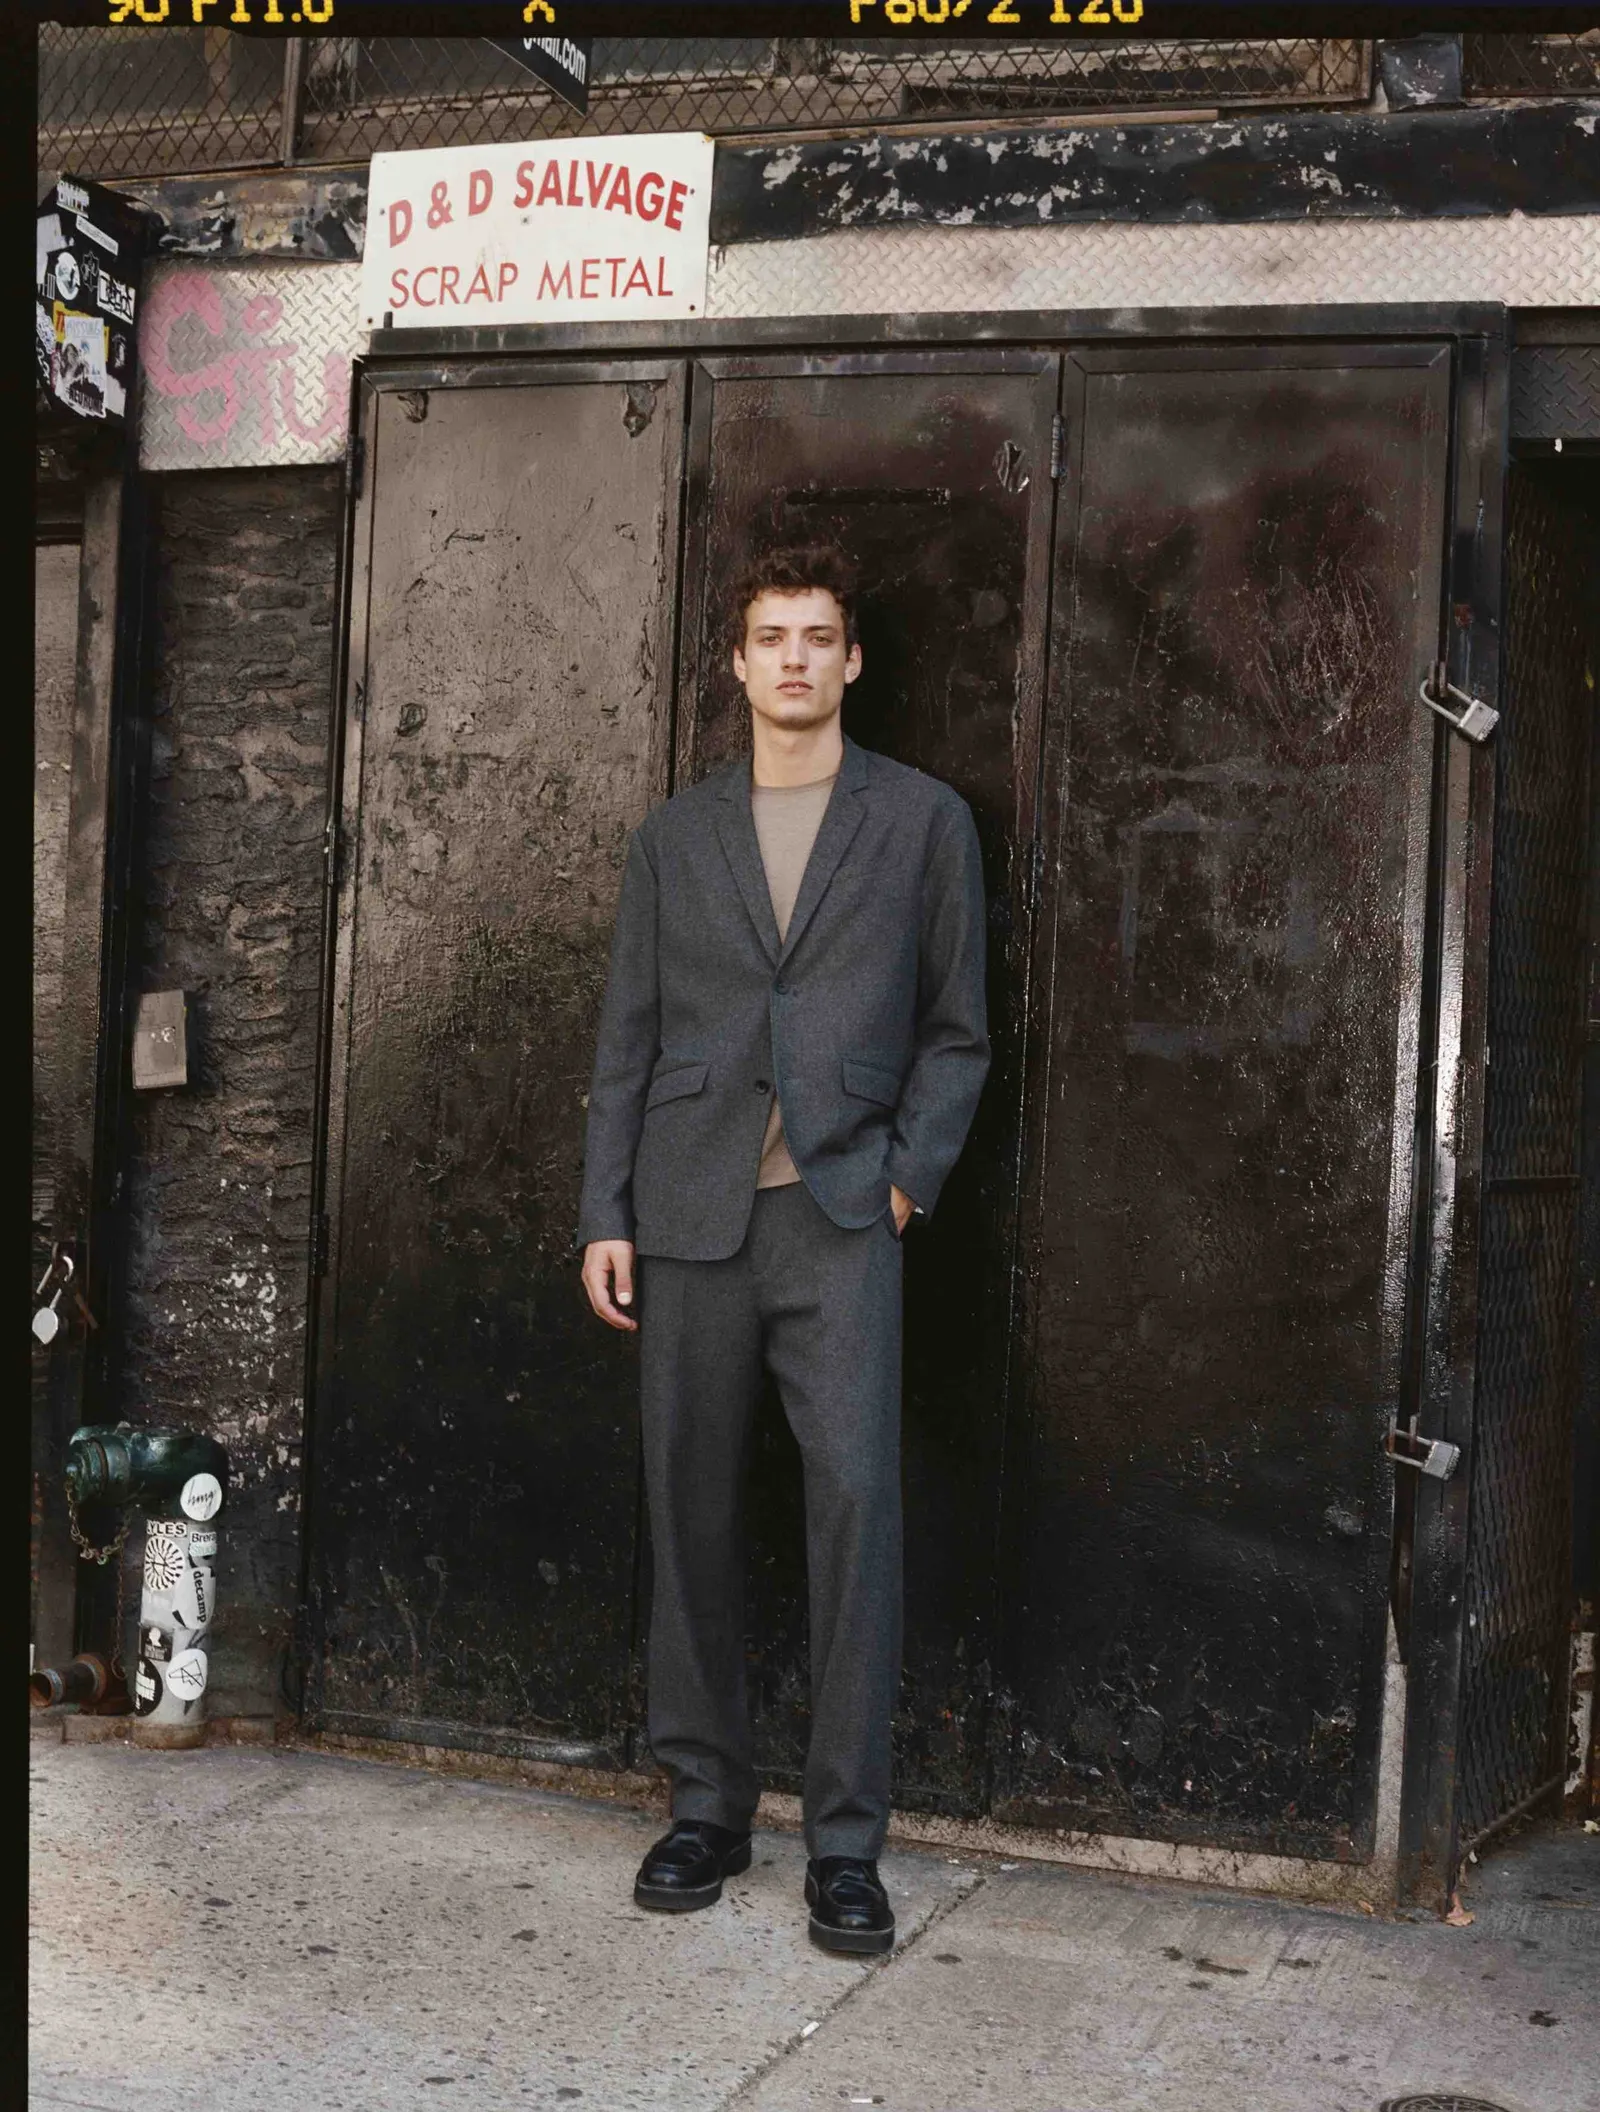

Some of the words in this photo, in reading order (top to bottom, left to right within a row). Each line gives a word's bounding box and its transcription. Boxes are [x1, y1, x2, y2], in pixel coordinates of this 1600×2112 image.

[523, 37, 587, 85] ail.com
[389, 200, 413, 248] D
[427, 181, 453, 229] &
[469, 169, 493, 216] D
[513, 159, 688, 231] SALVAGE
[390, 262, 518, 308] SCRAP
[537, 257, 673, 301] METAL
[147, 1521, 185, 1536] YLES
[193, 1571, 207, 1623] decamp
